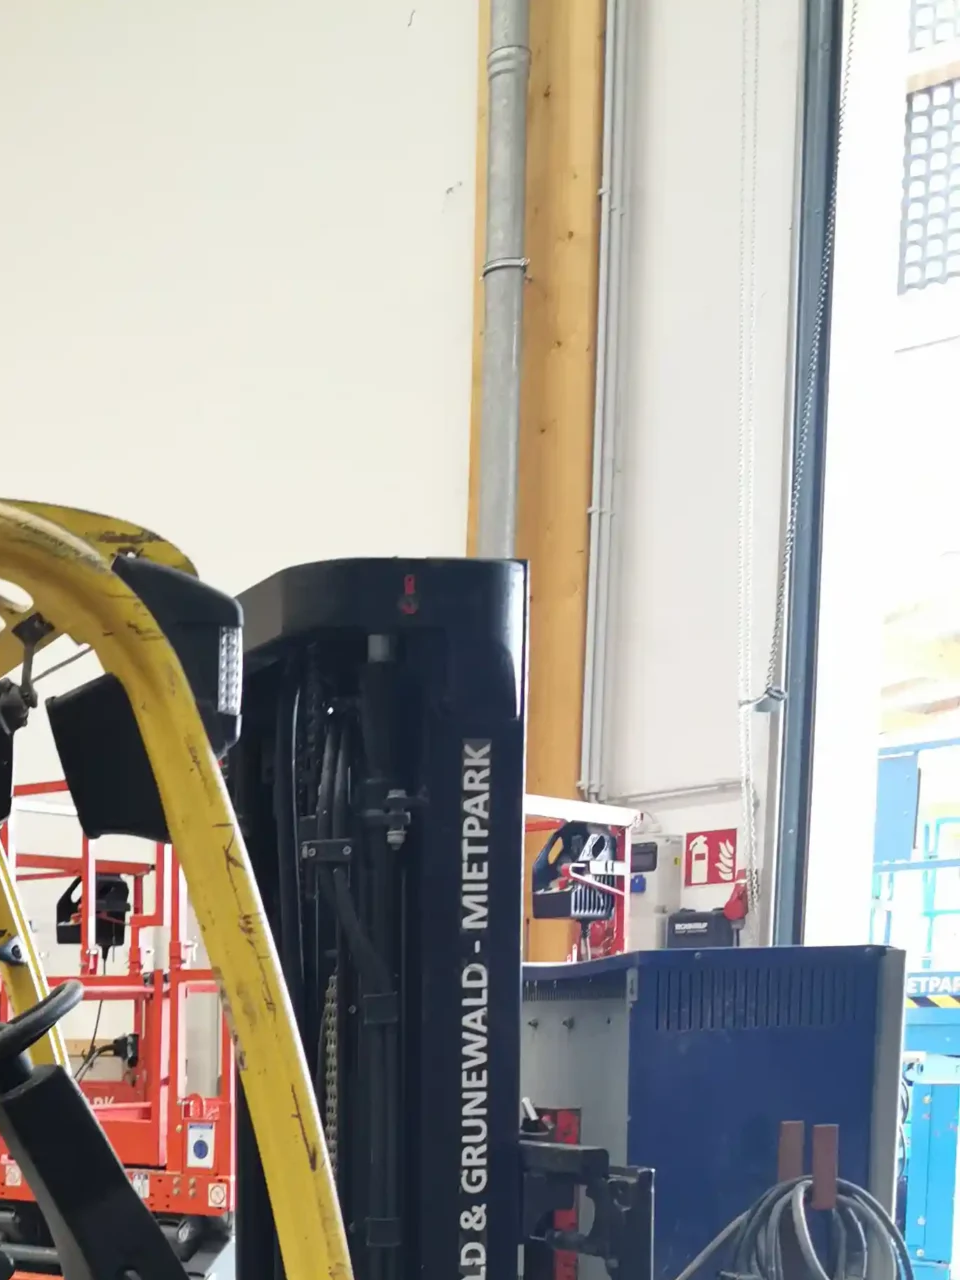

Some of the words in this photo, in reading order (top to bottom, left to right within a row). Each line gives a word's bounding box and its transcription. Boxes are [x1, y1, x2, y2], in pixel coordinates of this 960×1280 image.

[462, 743, 491, 929] MIETPARK
[461, 962, 489, 1194] GRUNEWALD
[459, 1203, 487, 1232] &
